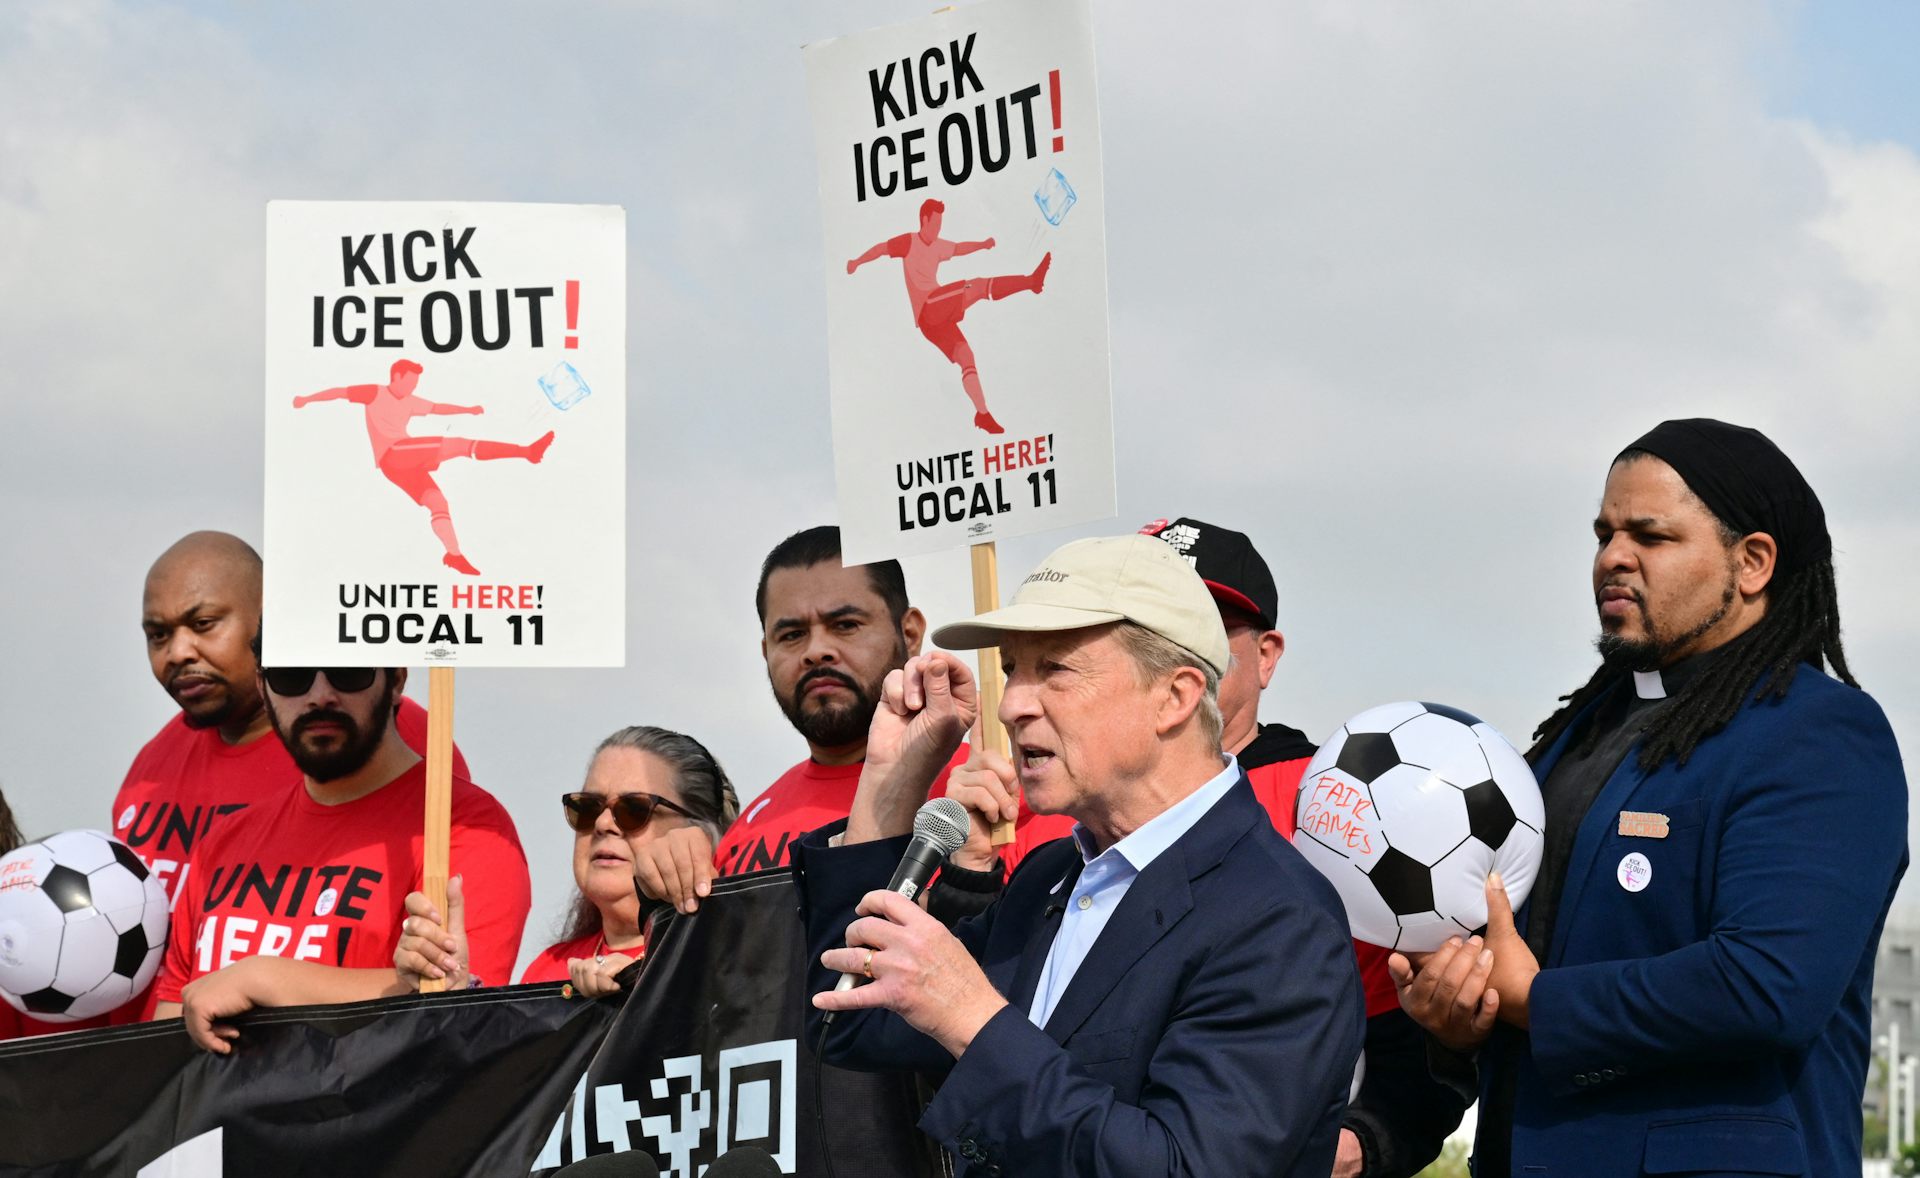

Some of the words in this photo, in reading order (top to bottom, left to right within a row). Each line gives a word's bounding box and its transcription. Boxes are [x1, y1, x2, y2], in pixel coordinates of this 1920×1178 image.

[869, 33, 984, 128] KICK
[854, 128, 928, 202] ICE
[938, 70, 1064, 187] OUT!
[342, 228, 481, 286] KICK
[314, 296, 404, 347] ICE
[421, 280, 580, 353] OUT!
[897, 450, 974, 491] UNITE
[984, 434, 1055, 475] HERE!
[899, 478, 1011, 531] LOCAL
[1027, 469, 1057, 507] 11
[339, 584, 438, 609] UNITE
[452, 585, 543, 609] HERE!
[338, 613, 483, 644] LOCAL
[507, 615, 543, 646] 11
[1302, 802, 1372, 854] GAMES
[1312, 776, 1372, 822] FAIR
[203, 862, 383, 920] UNITE
